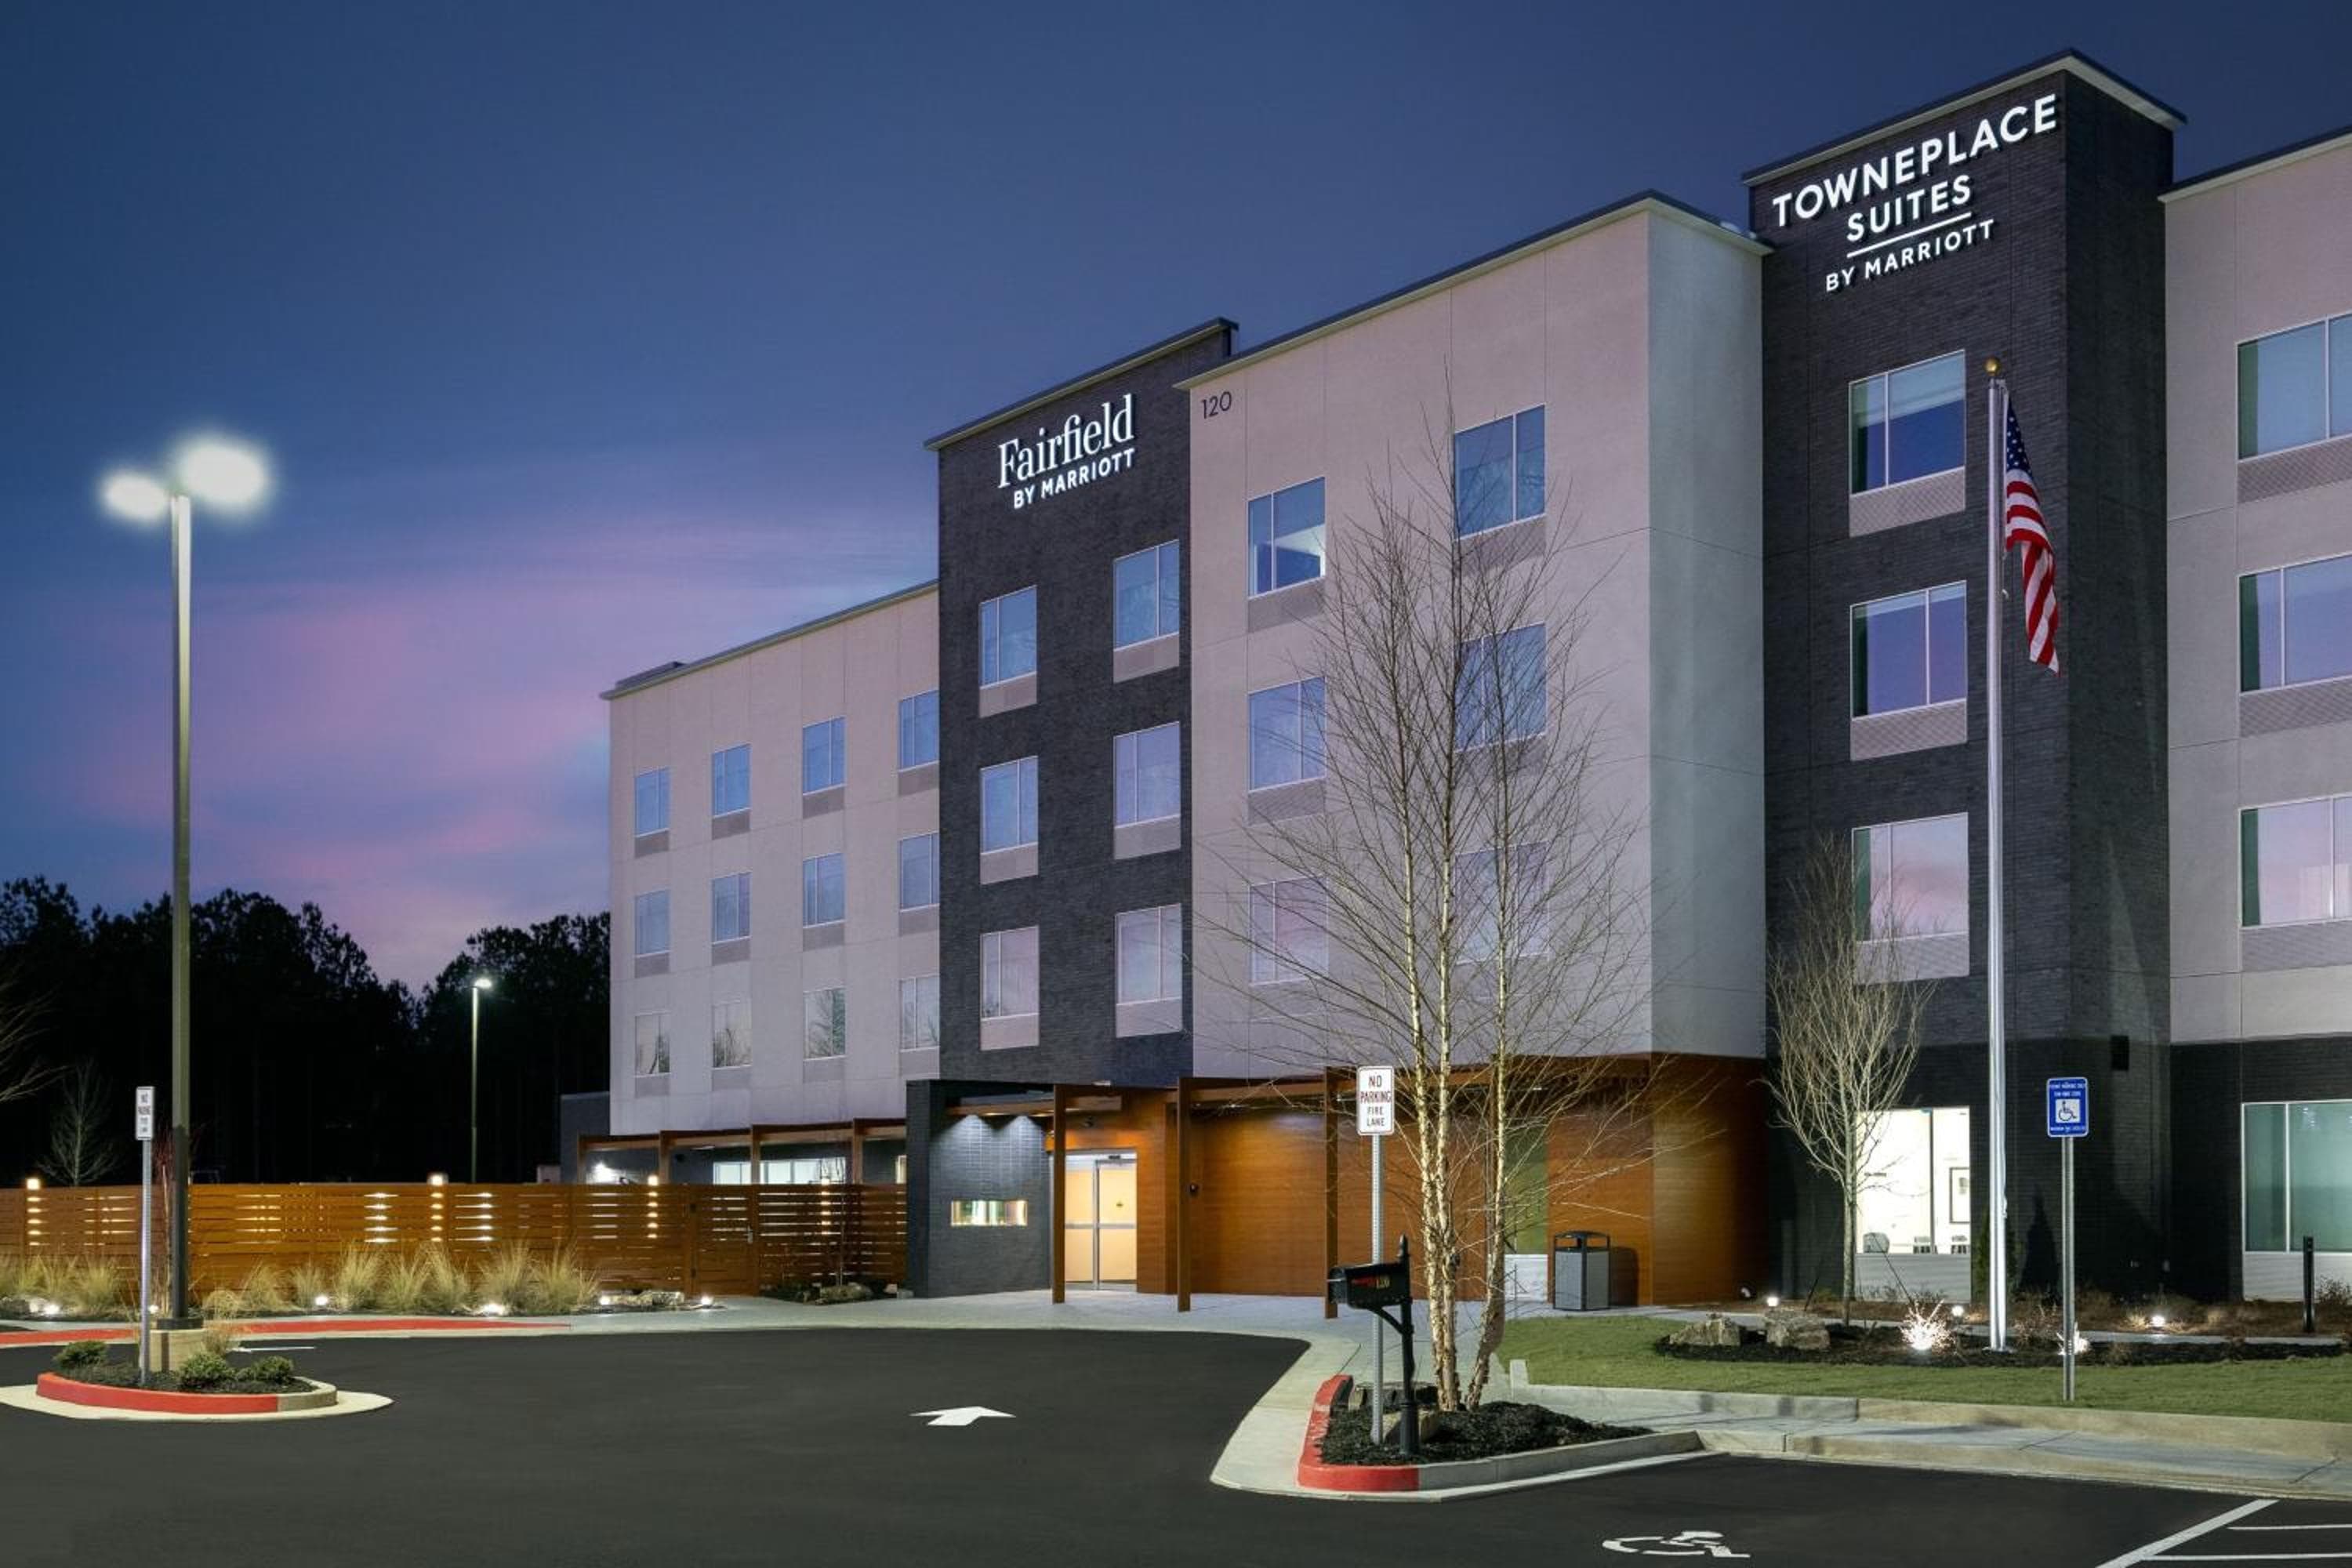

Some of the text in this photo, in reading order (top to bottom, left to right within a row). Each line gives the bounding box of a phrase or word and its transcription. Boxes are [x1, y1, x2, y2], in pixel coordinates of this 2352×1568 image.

[1772, 93, 2057, 227] TOWNEPLACE
[1846, 174, 1971, 242] SUITES
[1825, 219, 1995, 292] BY MARRIOTT
[1201, 391, 1232, 419] 120
[997, 393, 1135, 489] Fairfield
[1014, 448, 1135, 510] BY MARRIOTT
[1360, 1091, 1392, 1104] PARKING
[1369, 1075, 1382, 1087] NO
[1367, 1106, 1384, 1116] FIRE
[1367, 1117, 1385, 1127] LANE
